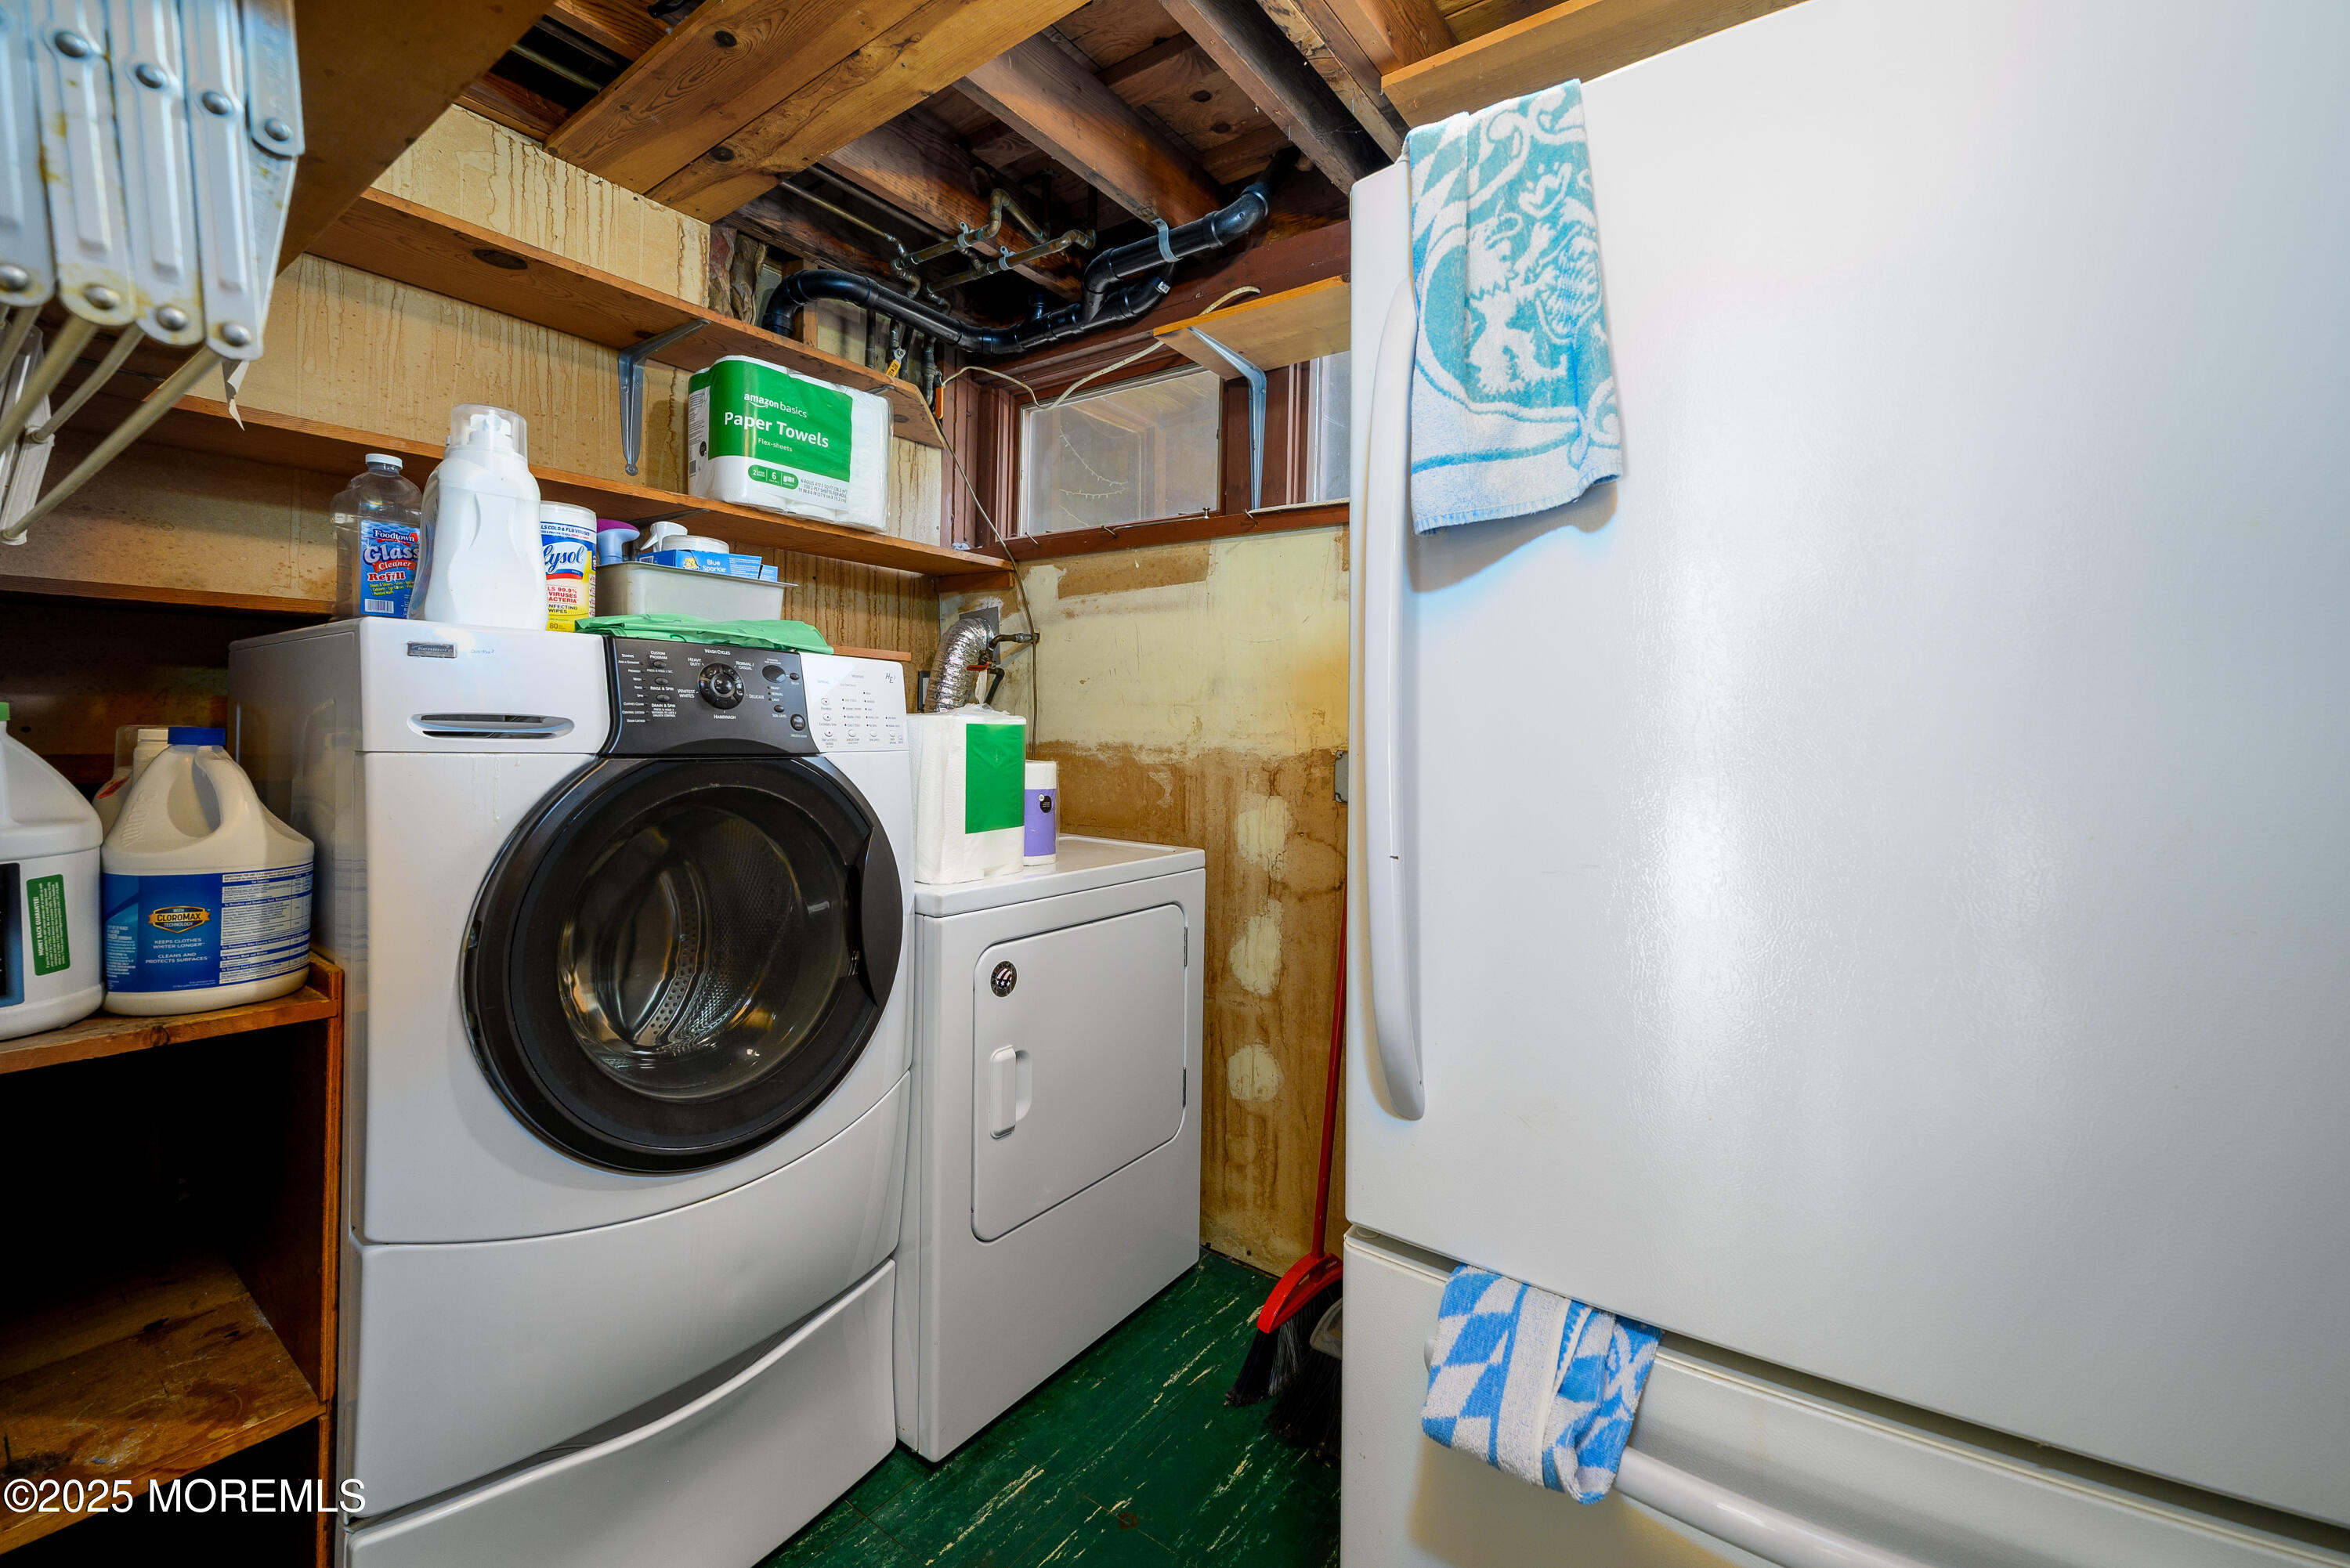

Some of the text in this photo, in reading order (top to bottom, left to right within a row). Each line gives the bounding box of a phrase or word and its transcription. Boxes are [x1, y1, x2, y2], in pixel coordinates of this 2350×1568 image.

[725, 412, 829, 448] Paper Towels
[757, 438, 793, 452] Flex-sheets
[772, 471, 777, 480] 6
[374, 529, 414, 542] Foodtown
[363, 544, 420, 564] Glass
[543, 544, 584, 573] Lysol
[378, 561, 412, 570] Cleaner
[702, 565, 727, 575] Sparkle
[367, 572, 406, 582] Refill
[33, 896, 42, 926] GUARANTEE!
[157, 913, 201, 922] CLOROMAX
